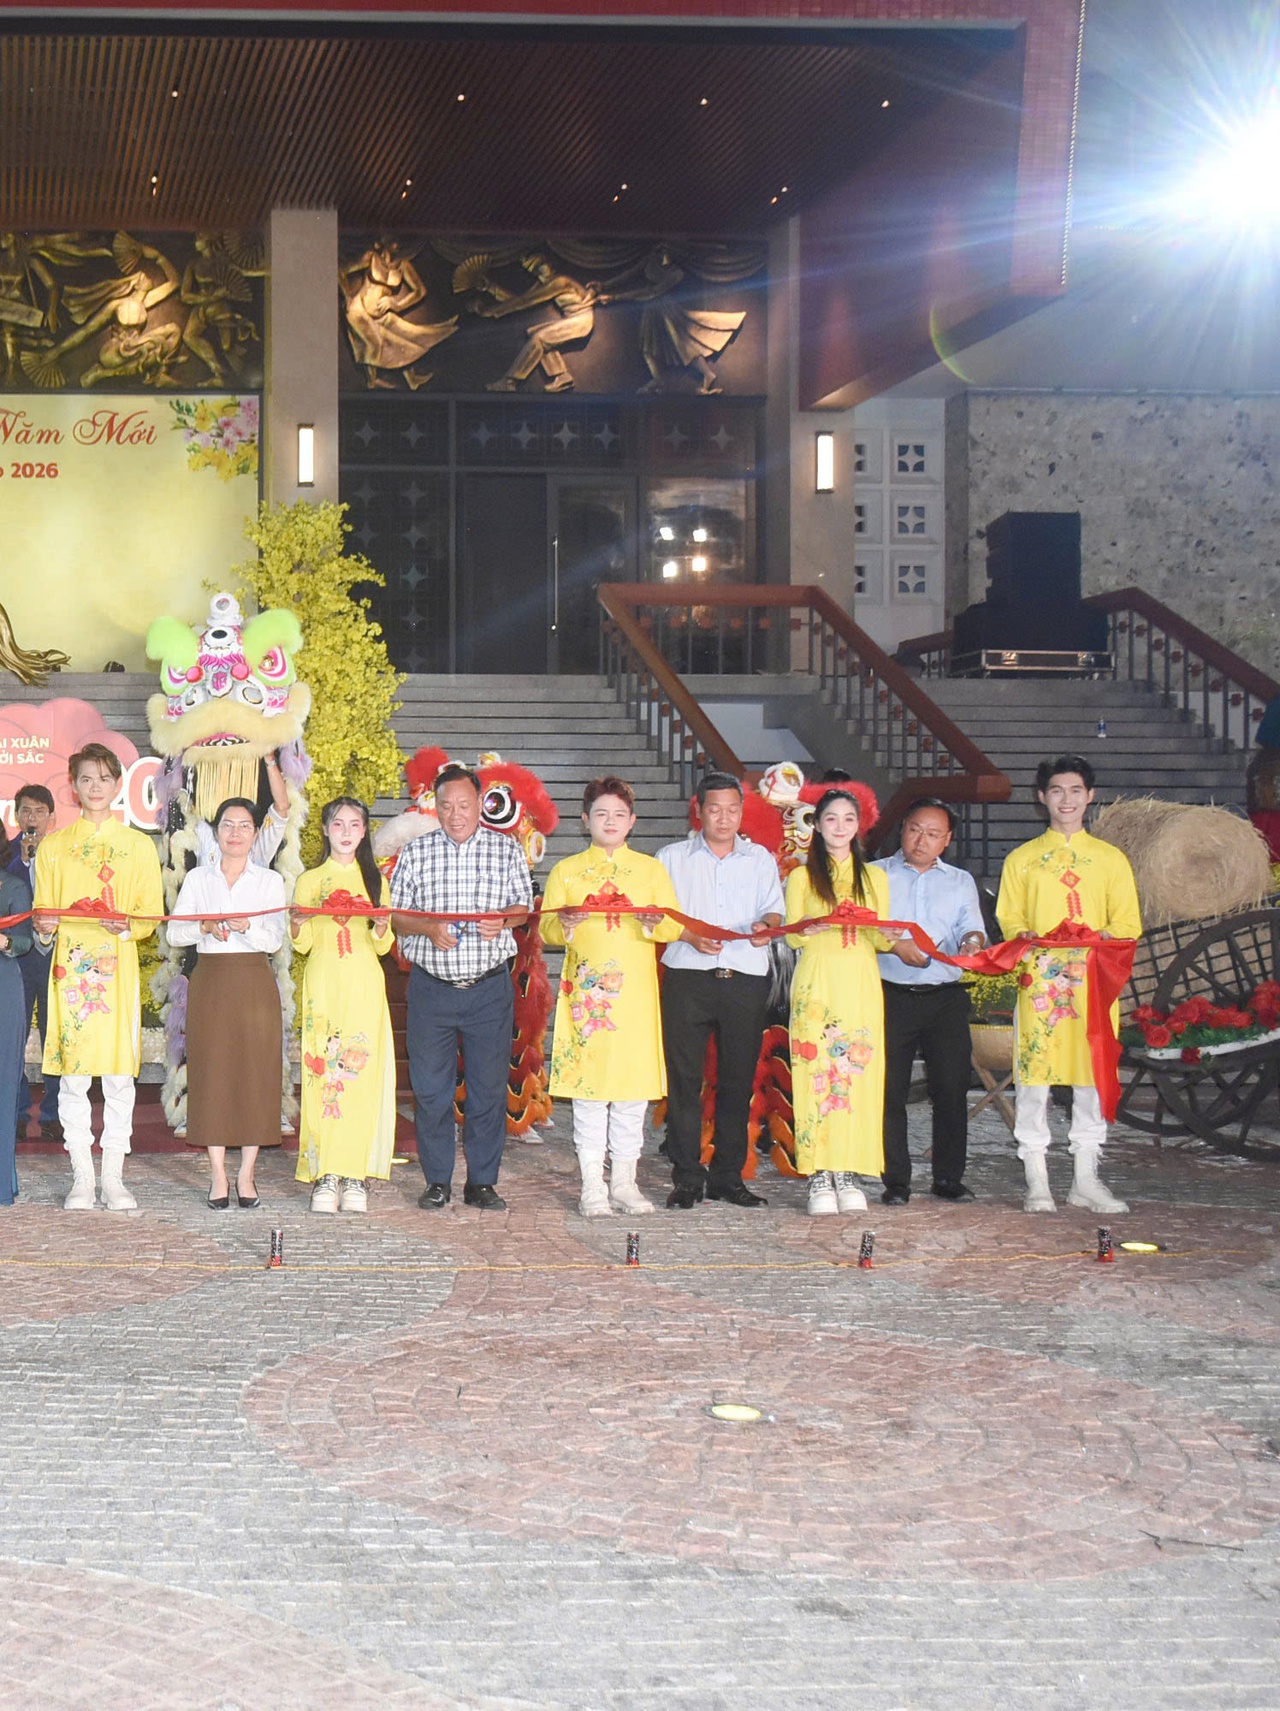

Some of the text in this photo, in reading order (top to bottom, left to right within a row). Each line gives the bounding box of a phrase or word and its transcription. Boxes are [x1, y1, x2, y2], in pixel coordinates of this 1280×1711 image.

[72, 409, 157, 446] Mới
[10, 462, 59, 479] 2026
[10, 735, 51, 749] XUÂN
[16, 749, 45, 765] SẮC
